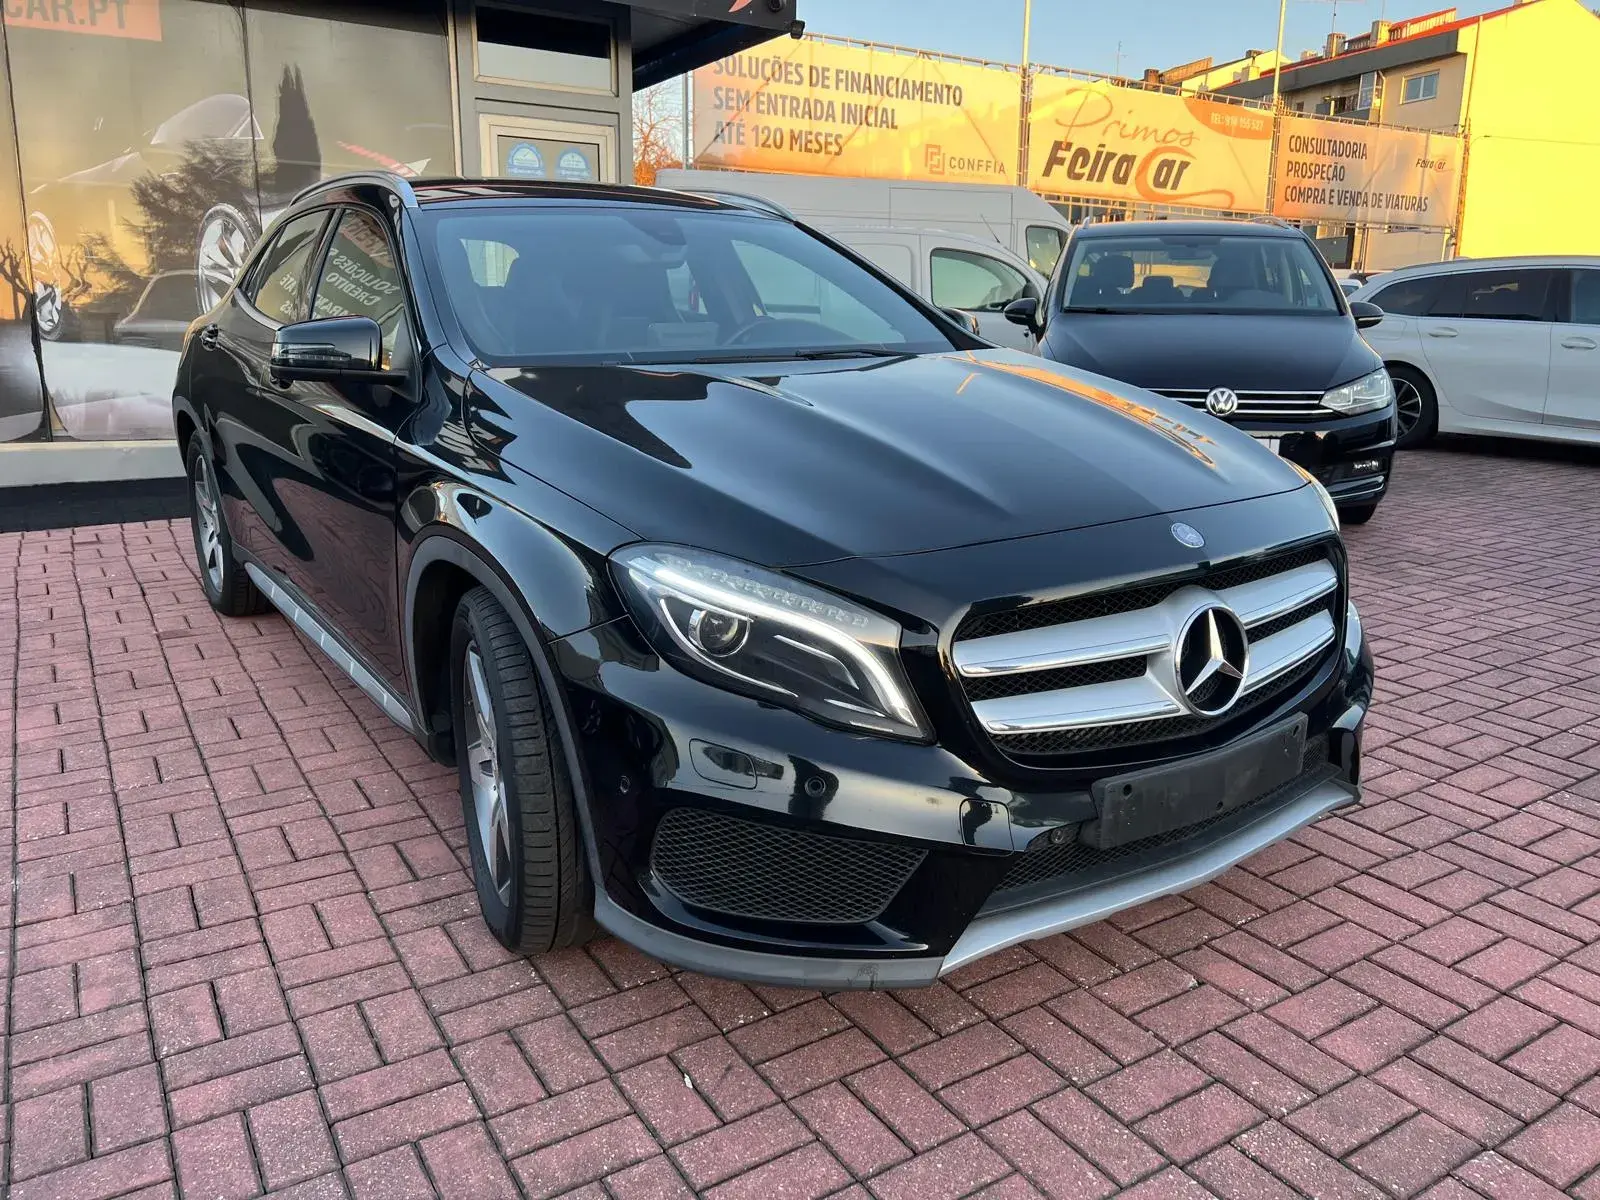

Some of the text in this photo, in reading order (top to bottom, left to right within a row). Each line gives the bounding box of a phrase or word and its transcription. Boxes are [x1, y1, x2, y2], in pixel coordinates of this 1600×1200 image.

[713, 54, 963, 107] SOLUÇÕES DE FINANCIAMENTO
[713, 86, 899, 130] SEM ENTRADA INICIAL
[1055, 88, 1200, 147] Primos
[714, 118, 844, 157] ATÉ 120 MESES
[1288, 135, 1368, 160] CONSULTADORIA
[949, 156, 1006, 175] CONFFIA
[1286, 160, 1346, 185] PROSPEÇÃO
[1284, 185, 1429, 213] COMPRA E VENDA DE VIATURAS
